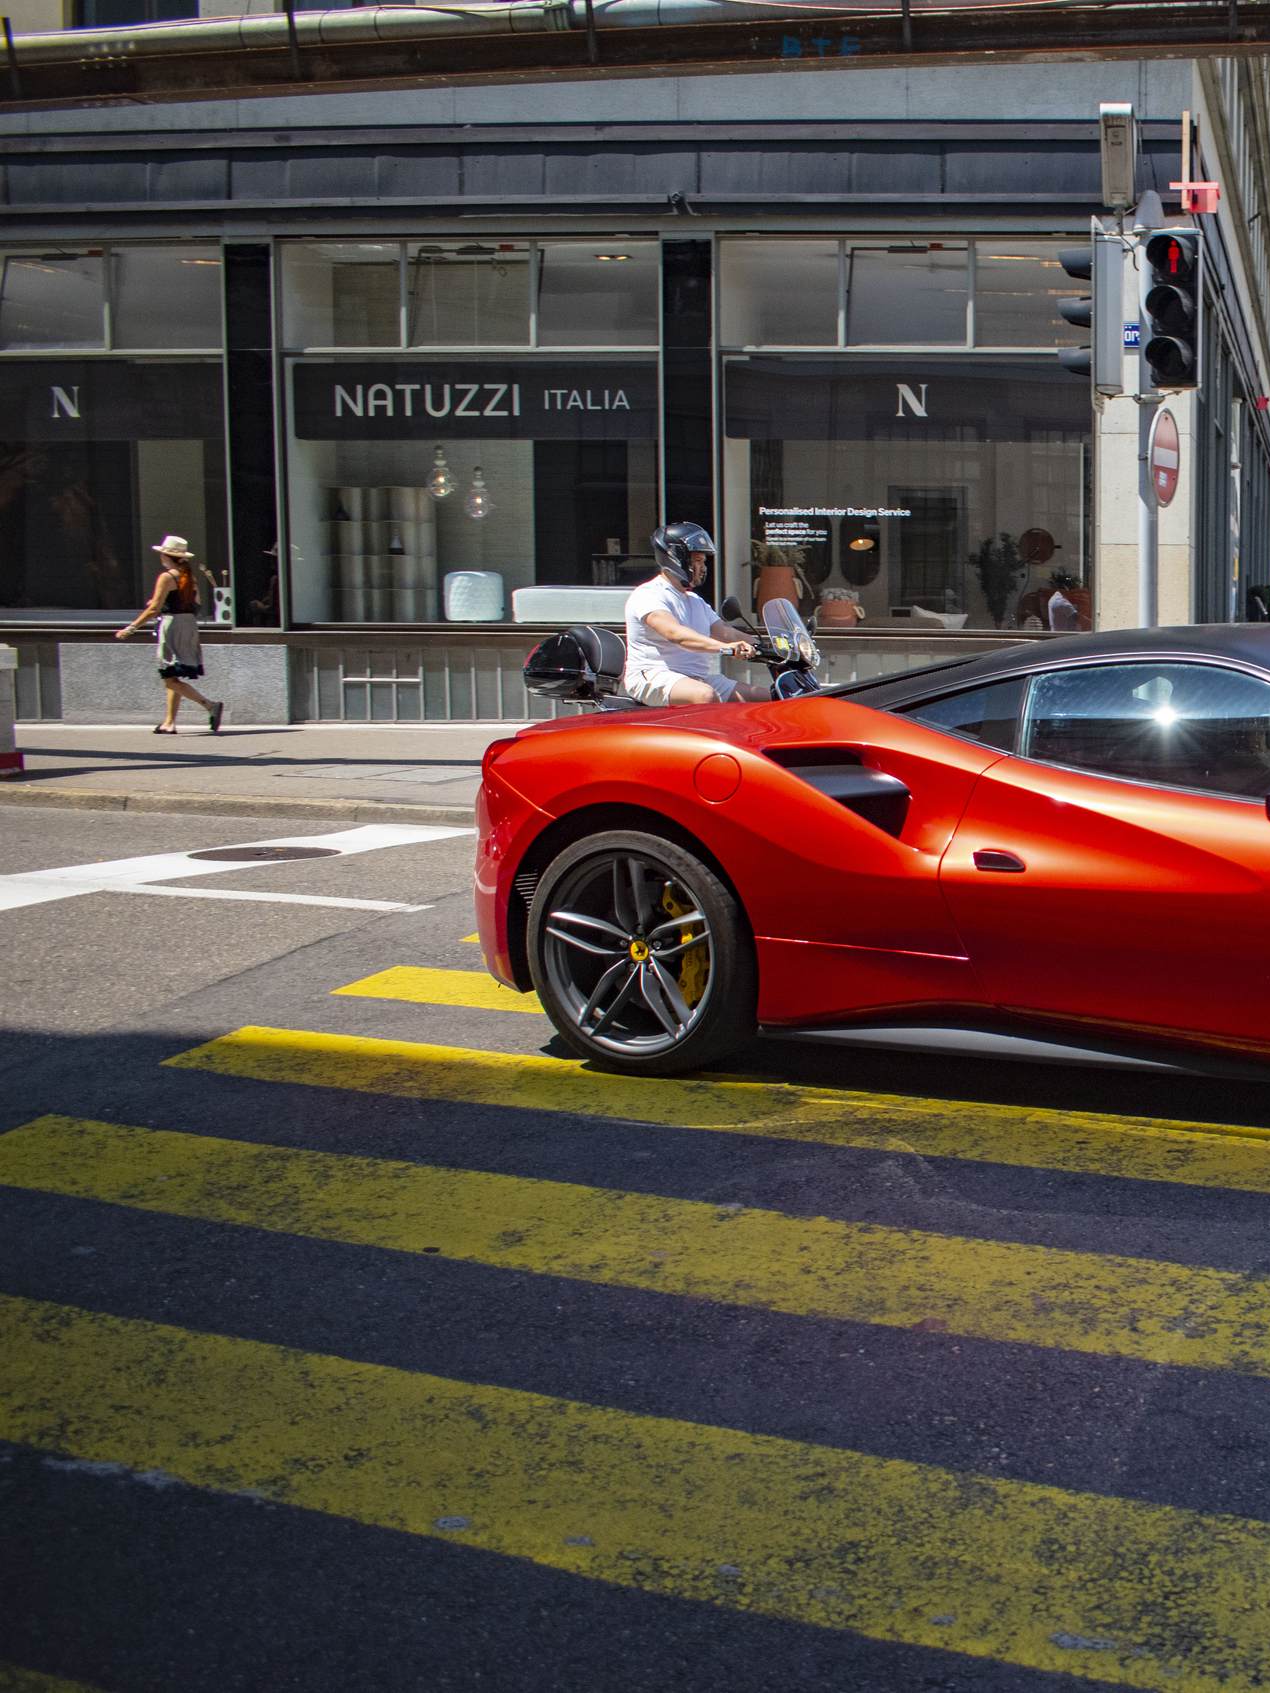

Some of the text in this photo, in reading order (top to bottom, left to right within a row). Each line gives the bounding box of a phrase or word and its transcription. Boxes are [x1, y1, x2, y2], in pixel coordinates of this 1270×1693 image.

[51, 386, 80, 418] N
[334, 384, 630, 417] NATUZZI ITALIA
[896, 384, 928, 417] N
[759, 506, 911, 518] Personalised Interior Design Service
